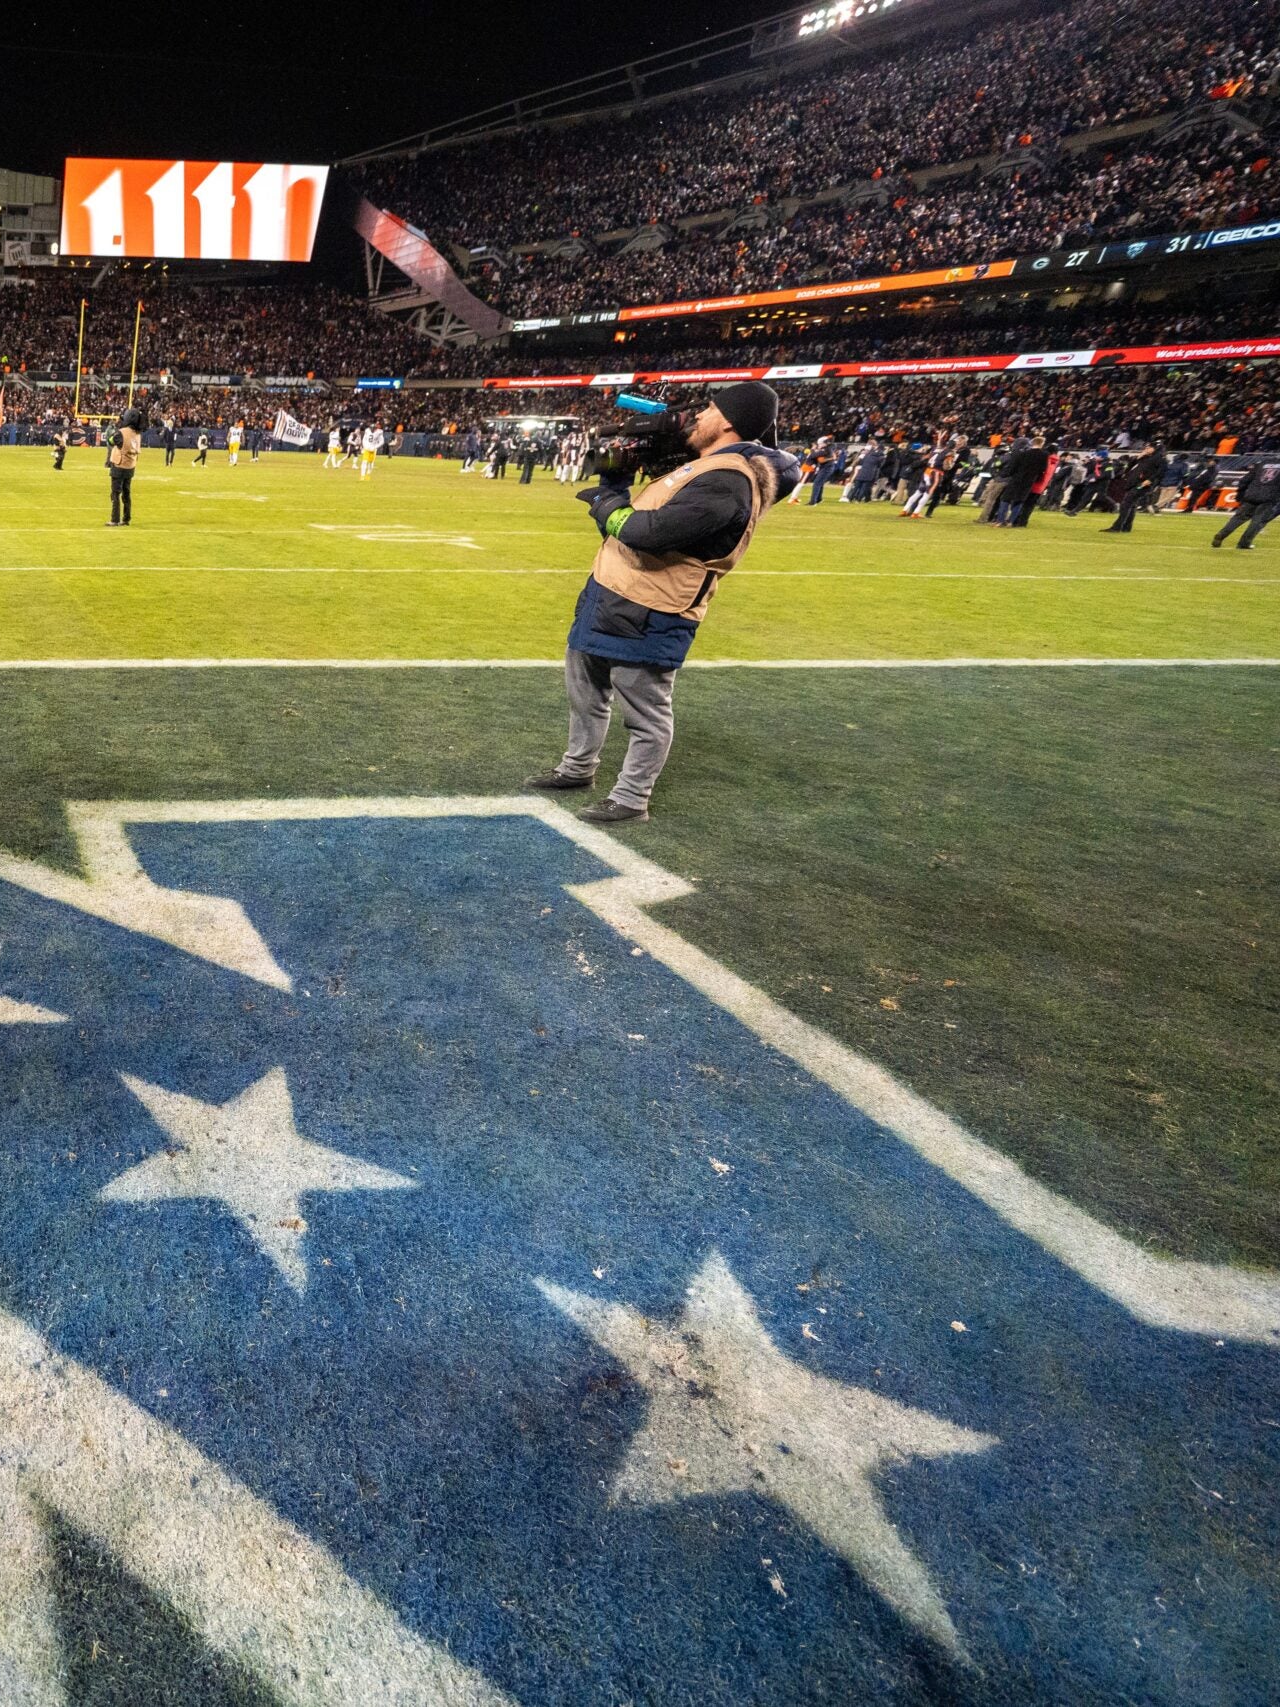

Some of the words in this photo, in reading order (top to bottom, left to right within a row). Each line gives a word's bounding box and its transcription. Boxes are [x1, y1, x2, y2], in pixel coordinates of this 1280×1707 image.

[1211, 223, 1280, 245] GEICO
[1165, 235, 1191, 254] 31
[1064, 250, 1089, 268] 27
[816, 285, 852, 297] CHICAGO
[852, 281, 882, 293] BEARS
[1155, 349, 1185, 359] Work
[1183, 344, 1256, 359] productively
[191, 375, 230, 385] BEAR
[265, 376, 307, 386] DOWN
